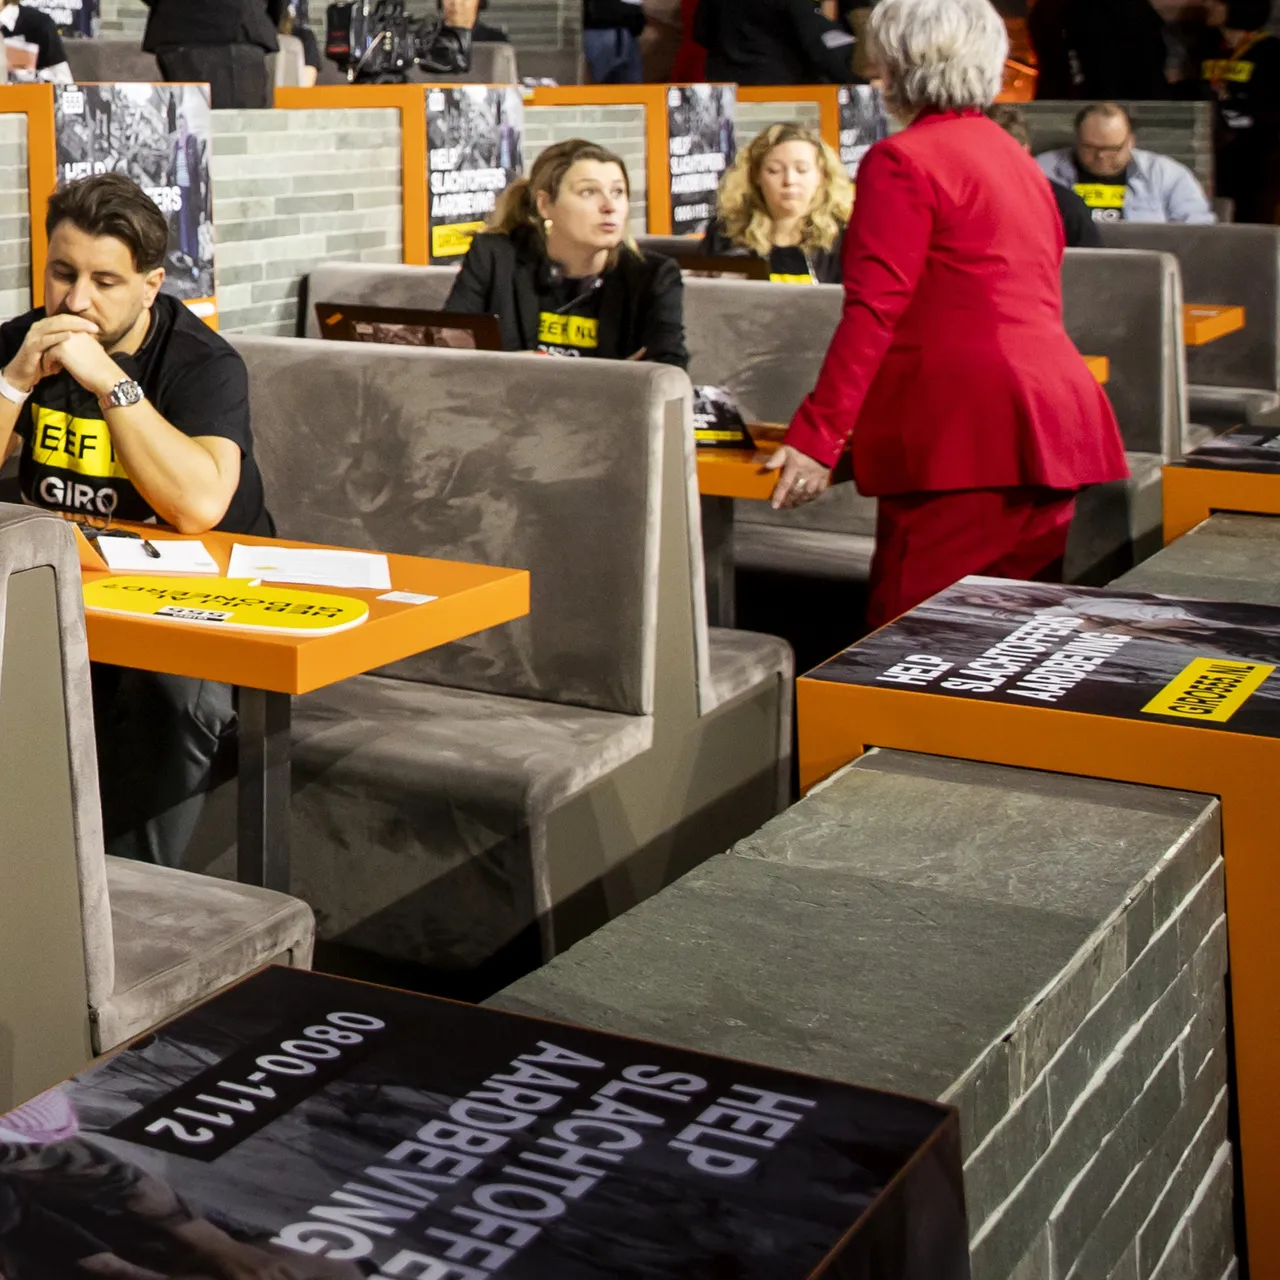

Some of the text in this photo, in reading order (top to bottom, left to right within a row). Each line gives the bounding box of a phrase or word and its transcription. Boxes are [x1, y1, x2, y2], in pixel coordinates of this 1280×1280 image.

[33, 423, 99, 462] EEF
[39, 476, 119, 515] GIRO
[875, 653, 955, 686] HELP
[940, 614, 1085, 694] SLACHTOFFERS
[1005, 631, 1133, 702] AARDBEVING
[1166, 662, 1258, 717] GIRO555.NL
[144, 1009, 386, 1144] 0800-1112
[268, 1040, 606, 1261] AARDBEVING
[665, 1083, 818, 1178] HELP
[367, 1064, 709, 1280] SLACHTOFFE
